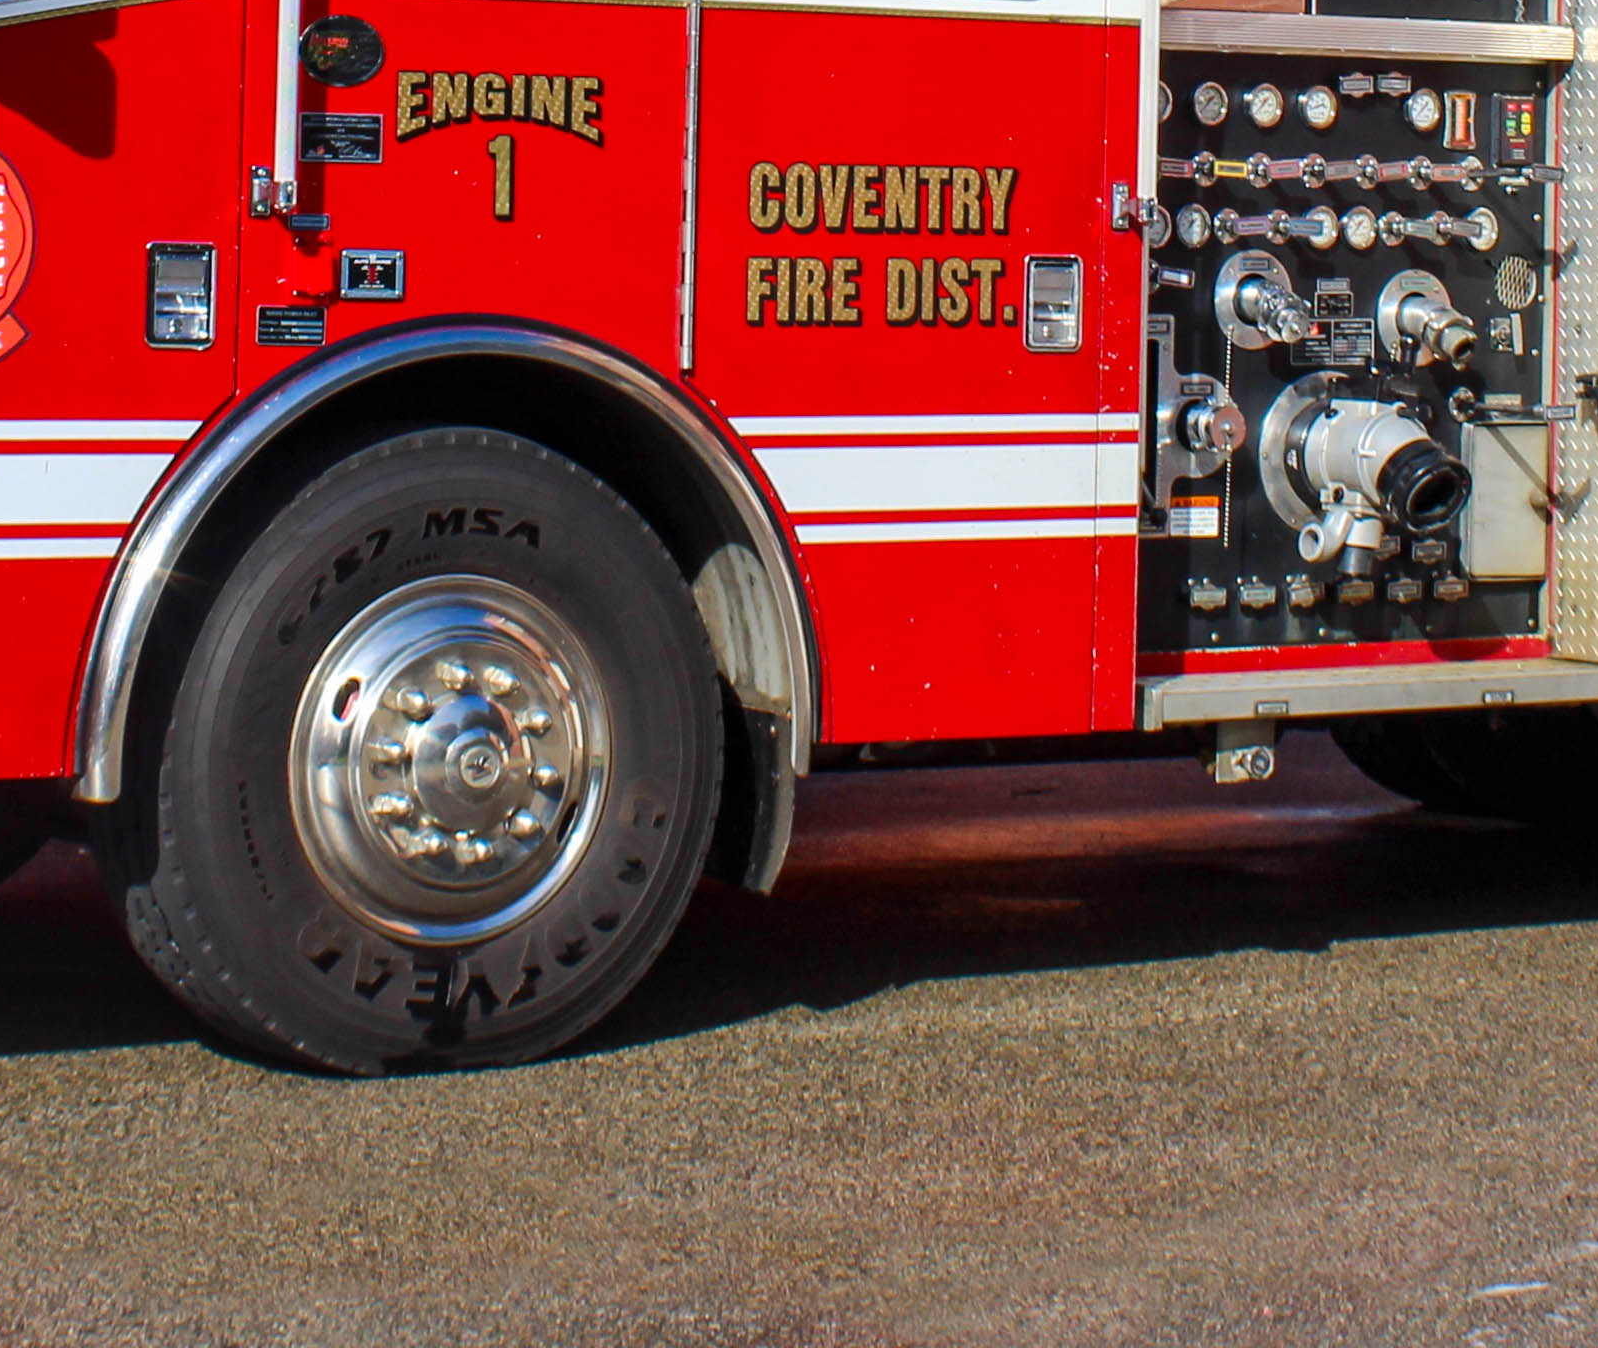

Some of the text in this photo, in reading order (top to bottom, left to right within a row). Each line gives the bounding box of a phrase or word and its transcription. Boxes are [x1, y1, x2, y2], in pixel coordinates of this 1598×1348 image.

[396, 70, 603, 145] ENGINE
[486, 134, 515, 221] 1
[746, 161, 1018, 236] COVENTRY
[744, 256, 1019, 328] FIRE DIST.
[421, 507, 541, 549] MSA
